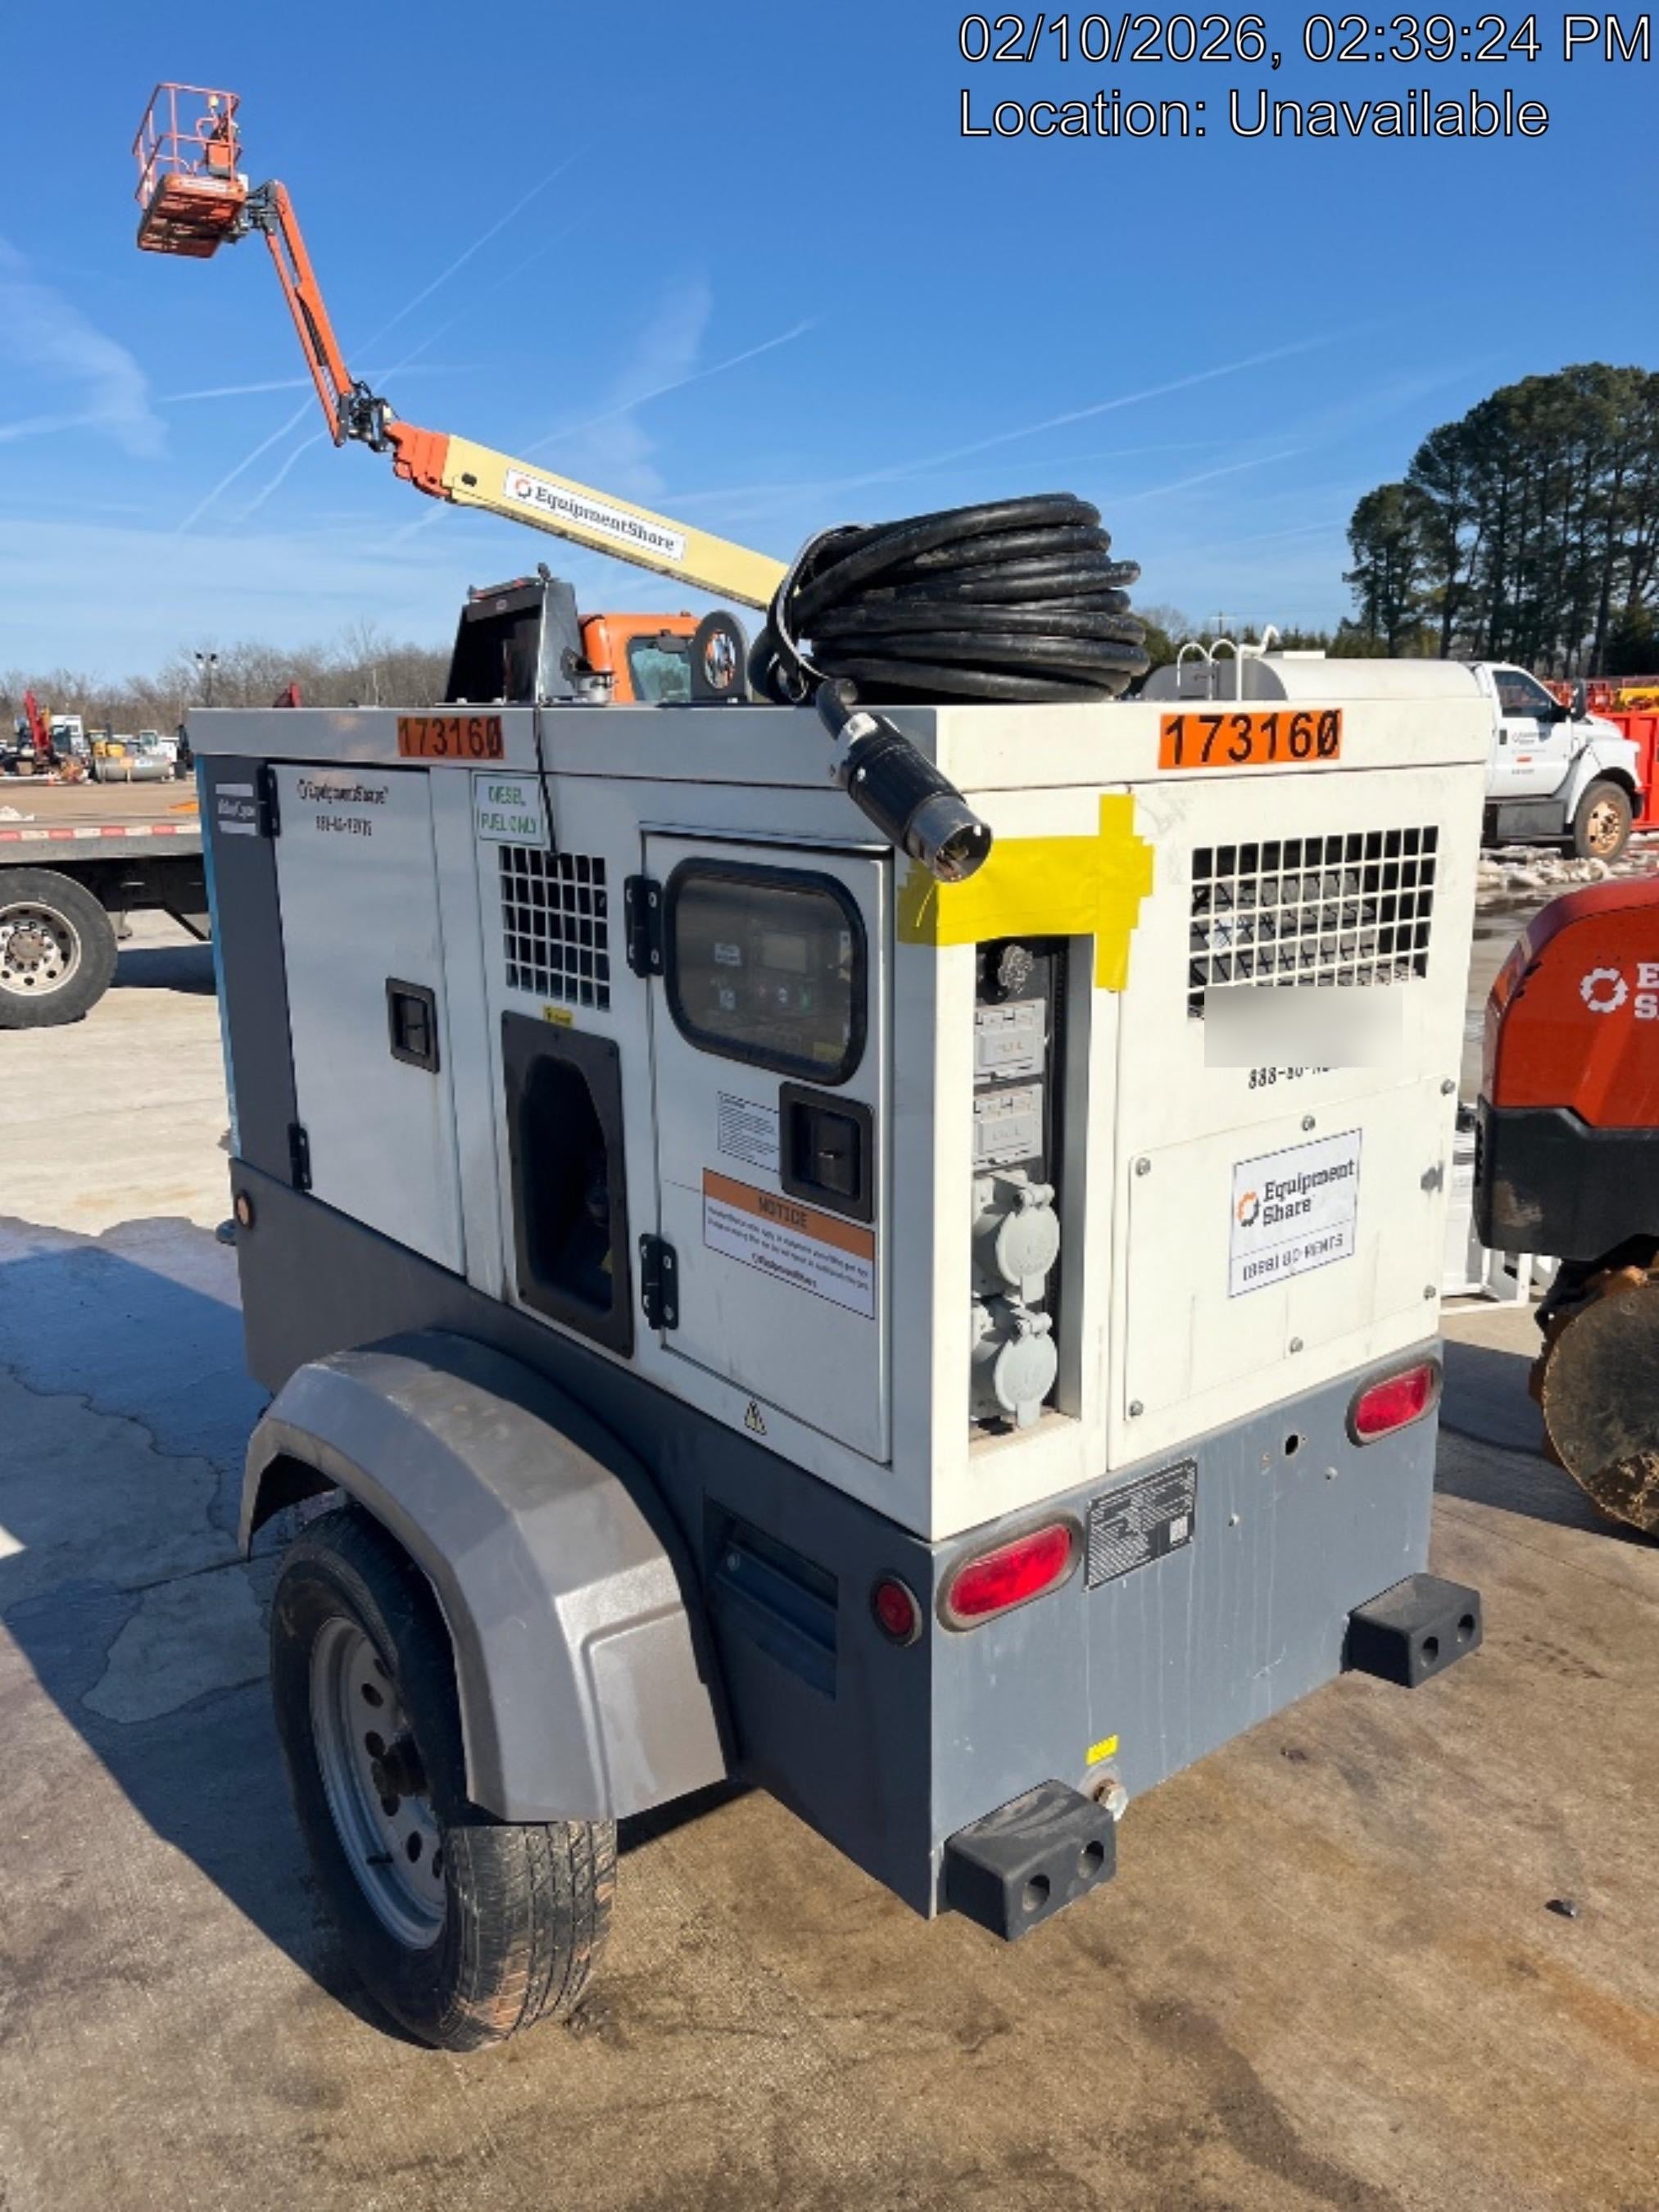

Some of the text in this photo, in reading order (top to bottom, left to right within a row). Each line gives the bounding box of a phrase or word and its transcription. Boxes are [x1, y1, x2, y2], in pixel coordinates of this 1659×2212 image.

[534, 485, 676, 552] EquipmentShare
[396, 715, 502, 757] 173160
[1163, 708, 1341, 765] 173160
[1263, 1158, 1355, 1202] Equipment
[759, 1195, 807, 1230] NOTICE
[1262, 1197, 1312, 1226] Share
